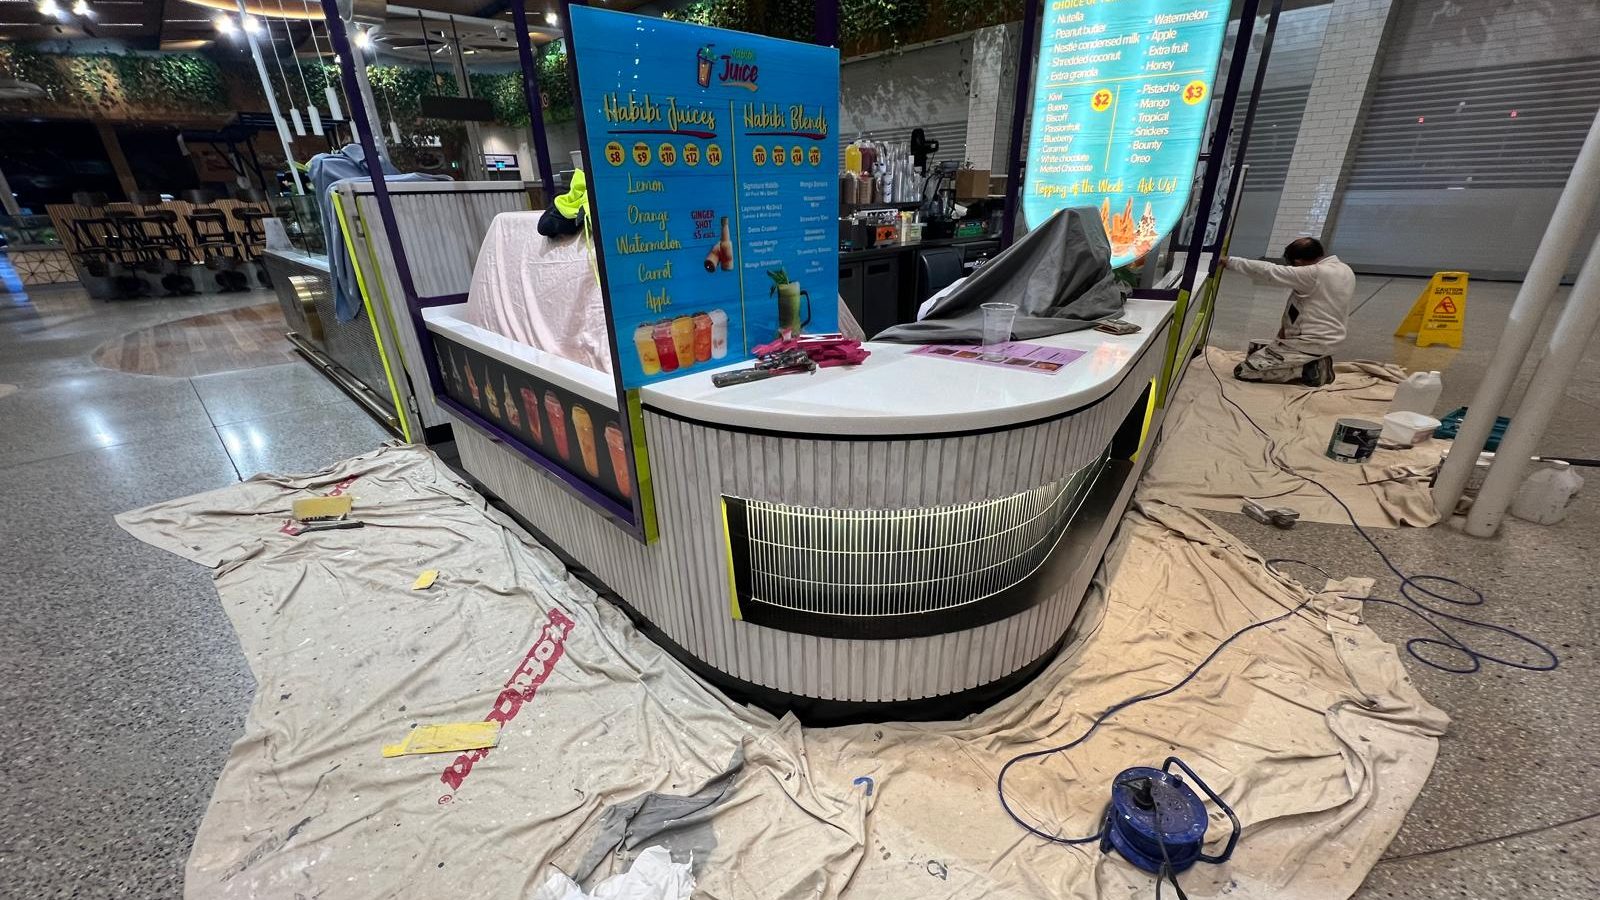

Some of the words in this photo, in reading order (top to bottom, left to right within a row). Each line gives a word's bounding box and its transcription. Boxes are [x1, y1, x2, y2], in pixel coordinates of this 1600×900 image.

[1057, 11, 1084, 23] Nutella
[1154, 10, 1208, 25] Watermelon
[1056, 26, 1083, 38] Peanut
[1083, 23, 1106, 35] butter
[1151, 28, 1177, 42] Apple
[1077, 36, 1121, 50] condensed
[1122, 33, 1140, 45] milk
[1149, 44, 1170, 56] Extra
[1171, 42, 1189, 54] fruit
[1051, 54, 1089, 67] Shredded
[1089, 51, 1121, 63] coconut
[719, 55, 759, 83] Juice
[1145, 60, 1175, 73] Honey
[1050, 70, 1069, 81] Extra
[1069, 68, 1098, 80] granola
[1142, 82, 1180, 94] Pistachio
[1186, 85, 1204, 100] $3
[1094, 93, 1110, 107] $2
[1139, 98, 1170, 110] Mango
[604, 92, 661, 123] Habibi
[666, 96, 717, 133] Juices
[1047, 103, 1068, 112] Bueno
[743, 103, 786, 129] Habibi
[790, 105, 829, 136] Blends
[1046, 113, 1068, 122] Biscoff
[1138, 111, 1169, 123] Tropical
[1135, 126, 1169, 137] Snickers
[1043, 134, 1074, 143] Blueberry
[1132, 139, 1162, 151] Bounty
[1042, 144, 1069, 153] Caramel
[610, 152, 621, 163] $8
[637, 152, 647, 163] $9
[661, 152, 674, 163] $10
[686, 152, 697, 163] $12
[709, 153, 720, 163] $14
[1130, 153, 1151, 164] Oreo
[627, 171, 665, 195] Lemon
[1034, 180, 1067, 198] Topping
[1081, 178, 1094, 194] the
[1099, 178, 1124, 193] Week
[1137, 177, 1155, 193] Ask
[1158, 177, 1178, 194] Us!
[628, 205, 670, 231] Orange
[690, 210, 714, 219] GINGER
[695, 220, 713, 229] SHOT
[616, 235, 683, 256] Watermelon
[638, 260, 673, 283] Carrot
[646, 287, 673, 314] Apple
